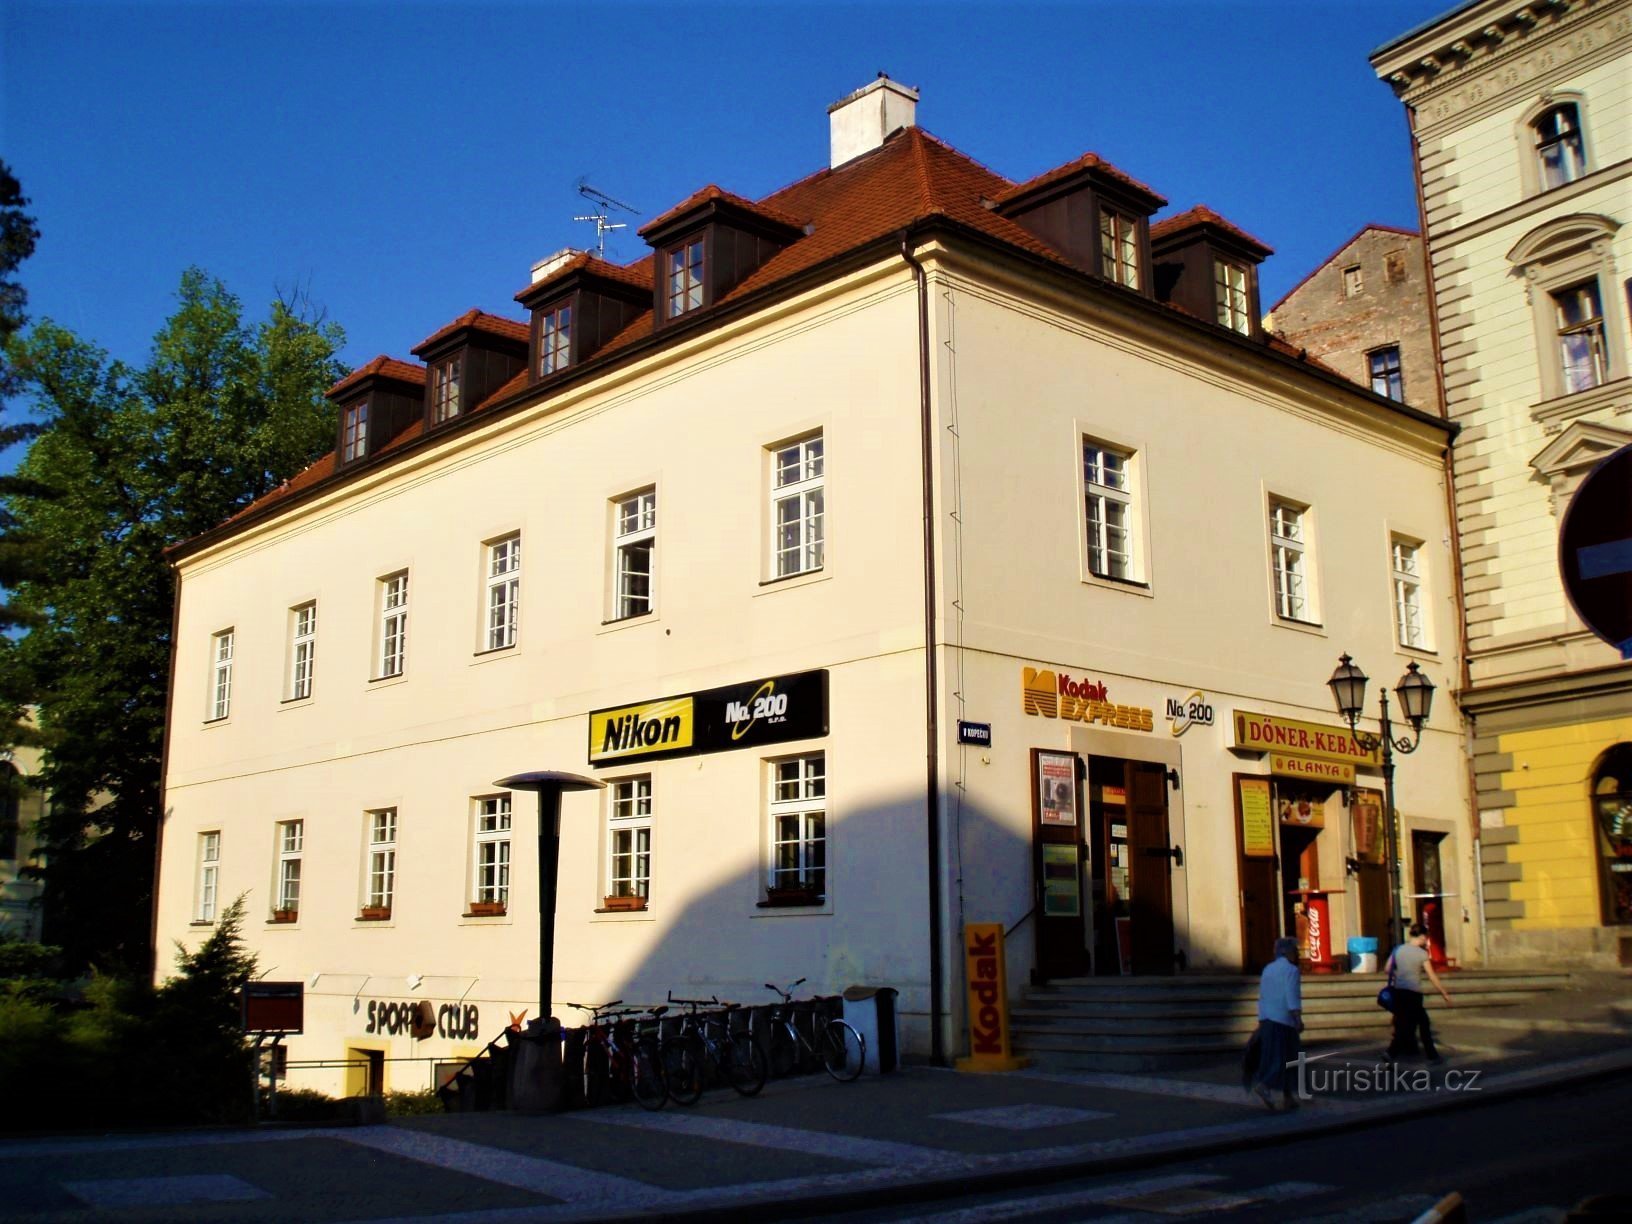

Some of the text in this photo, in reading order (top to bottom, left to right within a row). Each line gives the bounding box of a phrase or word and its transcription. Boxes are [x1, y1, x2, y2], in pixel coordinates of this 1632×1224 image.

[1059, 673, 1108, 703] Kodak
[753, 694, 788, 719] 200
[1061, 696, 1154, 732] EXPRESS
[1166, 698, 1213, 722] No. 200
[602, 714, 681, 753] Nikon
[1287, 759, 1340, 777] ALANYA
[969, 932, 1002, 1054] Kodak
[438, 1003, 479, 1041] CLUB
